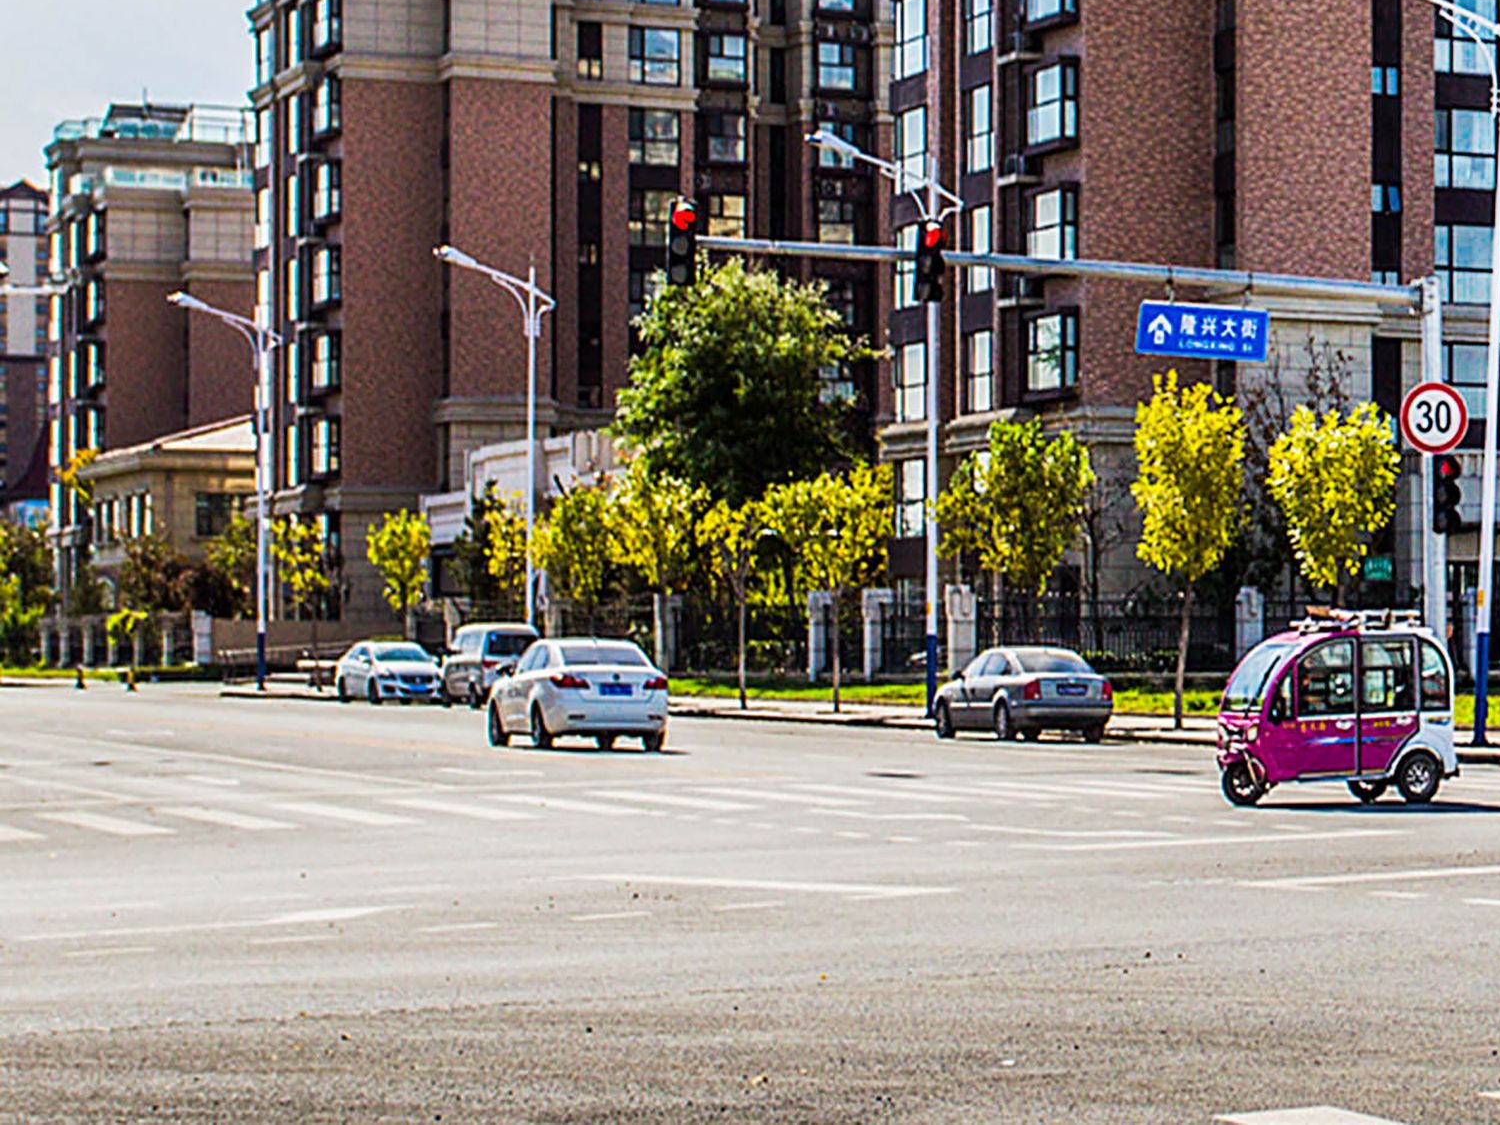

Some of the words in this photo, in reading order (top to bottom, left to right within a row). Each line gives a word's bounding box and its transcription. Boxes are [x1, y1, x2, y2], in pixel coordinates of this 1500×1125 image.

[1180, 314, 1258, 339] 隆兴大街
[1416, 400, 1451, 434] 30
